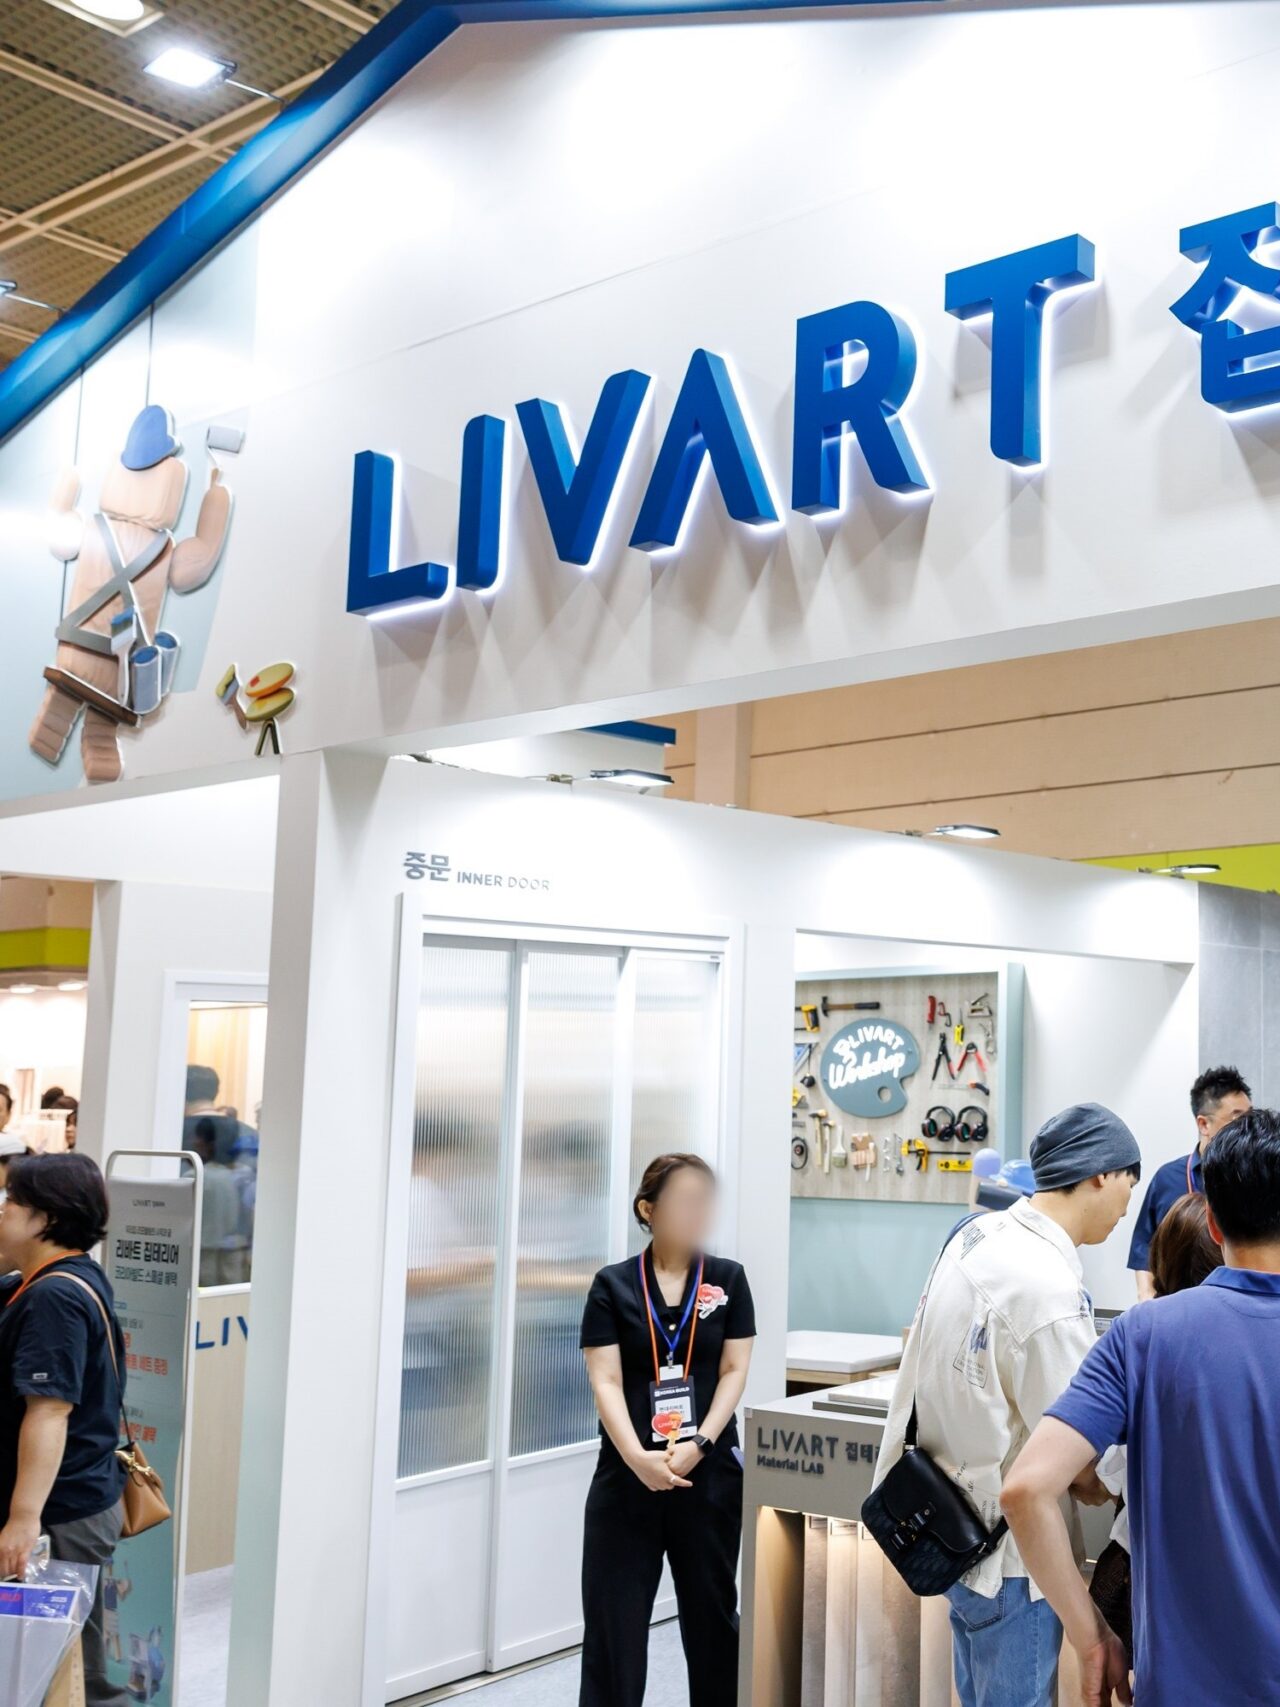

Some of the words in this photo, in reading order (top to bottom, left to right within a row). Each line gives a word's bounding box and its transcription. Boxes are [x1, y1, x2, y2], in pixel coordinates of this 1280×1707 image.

[346, 233, 1096, 616] LIVART
[403, 851, 451, 882] 중문
[457, 871, 503, 887] INNER
[508, 876, 550, 891] DOOR
[829, 1046, 905, 1089] Workshop
[116, 1239, 142, 1260] 리바트
[144, 1241, 179, 1265] 집테리어
[757, 1426, 839, 1460] LIVART
[757, 1454, 799, 1472] Material
[801, 1460, 824, 1475] LAB
